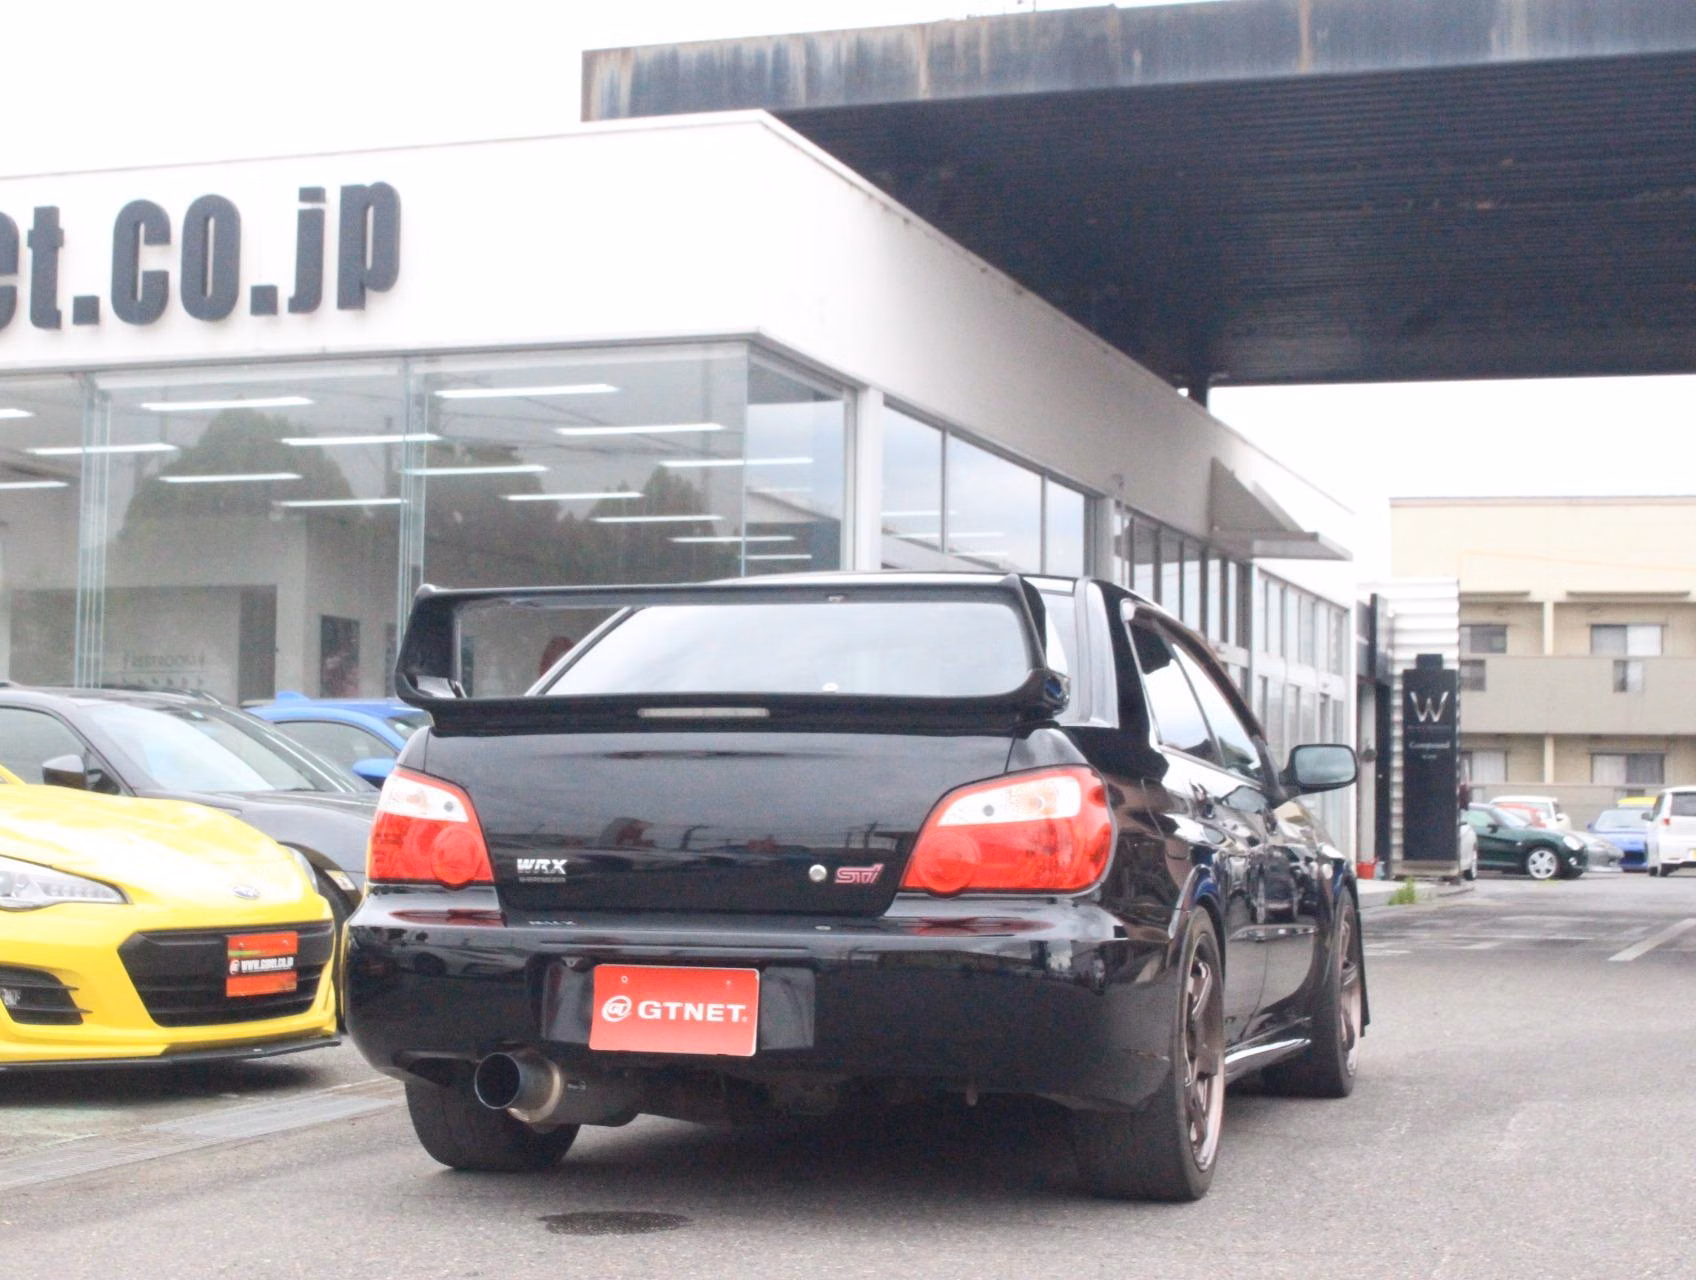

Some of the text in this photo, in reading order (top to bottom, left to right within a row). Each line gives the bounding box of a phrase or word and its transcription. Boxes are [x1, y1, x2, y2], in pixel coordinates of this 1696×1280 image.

[1409, 691, 1449, 723] W
[516, 858, 568, 875] WRX
[637, 1000, 746, 1023] GTNET
